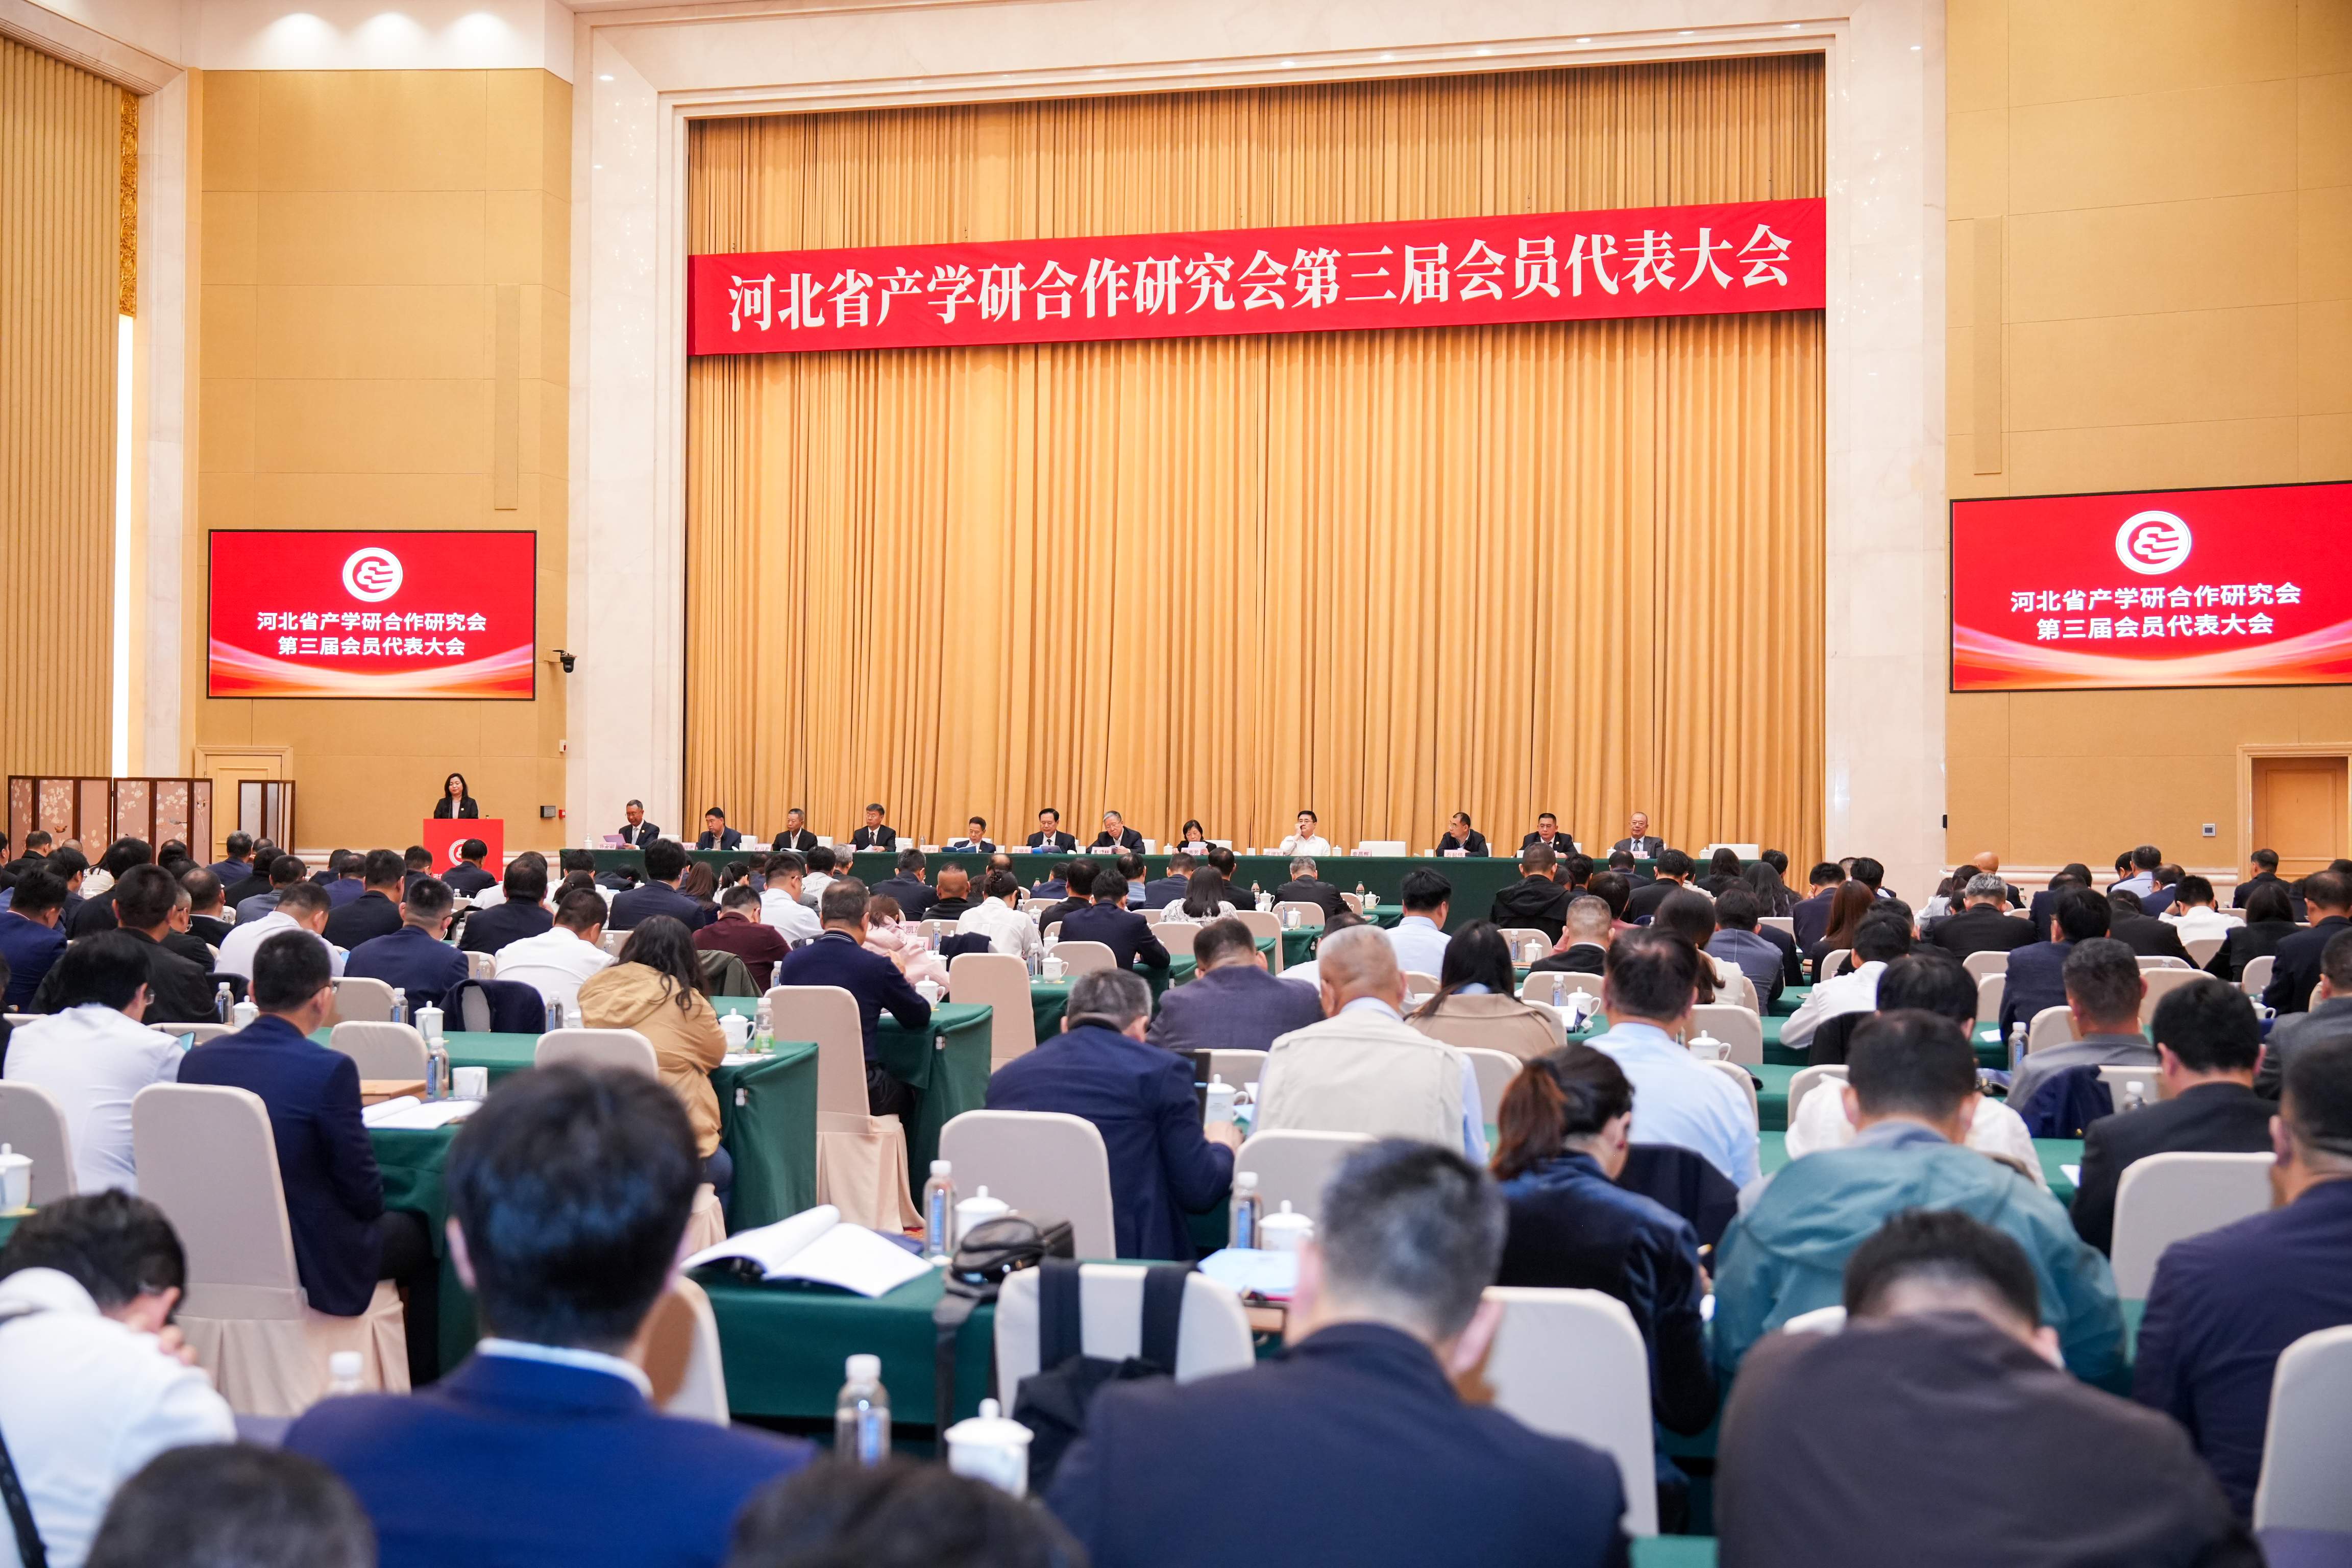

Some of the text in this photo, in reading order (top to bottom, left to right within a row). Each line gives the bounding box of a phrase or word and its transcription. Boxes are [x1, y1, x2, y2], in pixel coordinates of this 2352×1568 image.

[728, 223, 1792, 332] 河北省产学研合作研究会第三届会员代表大会
[2010, 581, 2301, 613] 河北省产学研合作研究会
[257, 612, 487, 632] 河北省产学研合作研究会
[2036, 612, 2274, 641] 第三届会员代表大会
[278, 636, 465, 656] 第三届会员代表大会
